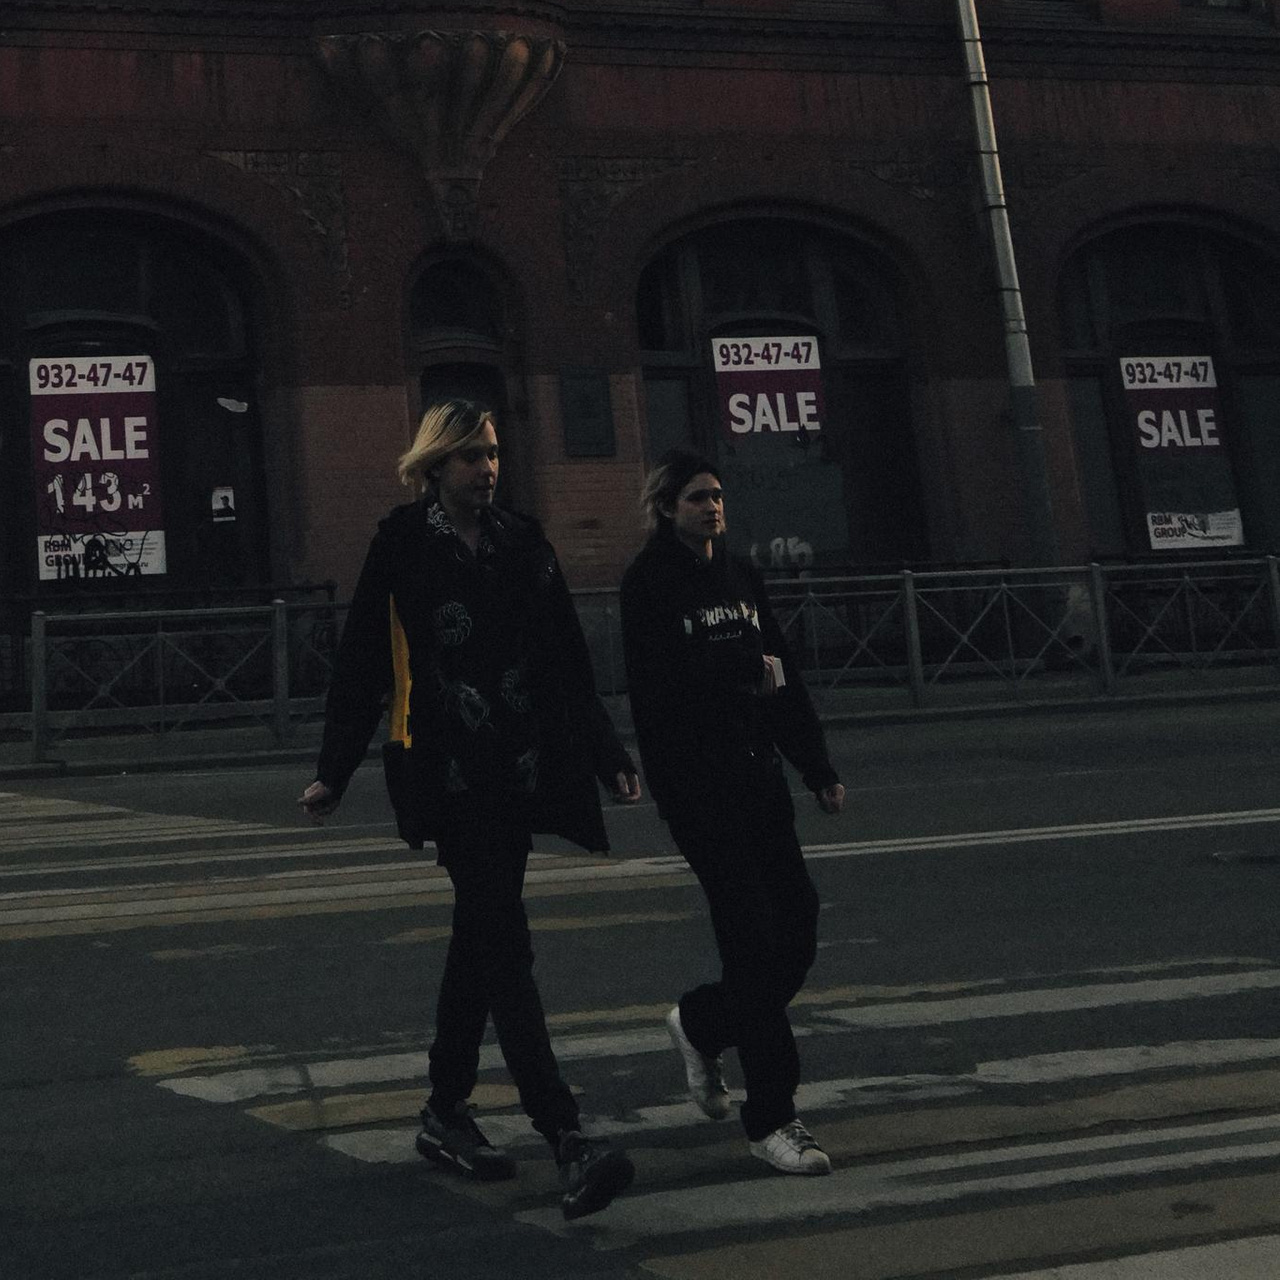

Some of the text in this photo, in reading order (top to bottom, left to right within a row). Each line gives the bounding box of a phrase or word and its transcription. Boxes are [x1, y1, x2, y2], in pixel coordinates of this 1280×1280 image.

[719, 342, 812, 366] 932-47-47
[1125, 361, 1208, 384] 932-47-47
[37, 362, 147, 388] 932-47-47
[728, 391, 821, 434] SALE
[1137, 409, 1220, 449] SALE
[43, 416, 150, 463] SALE
[47, 472, 122, 513] 143
